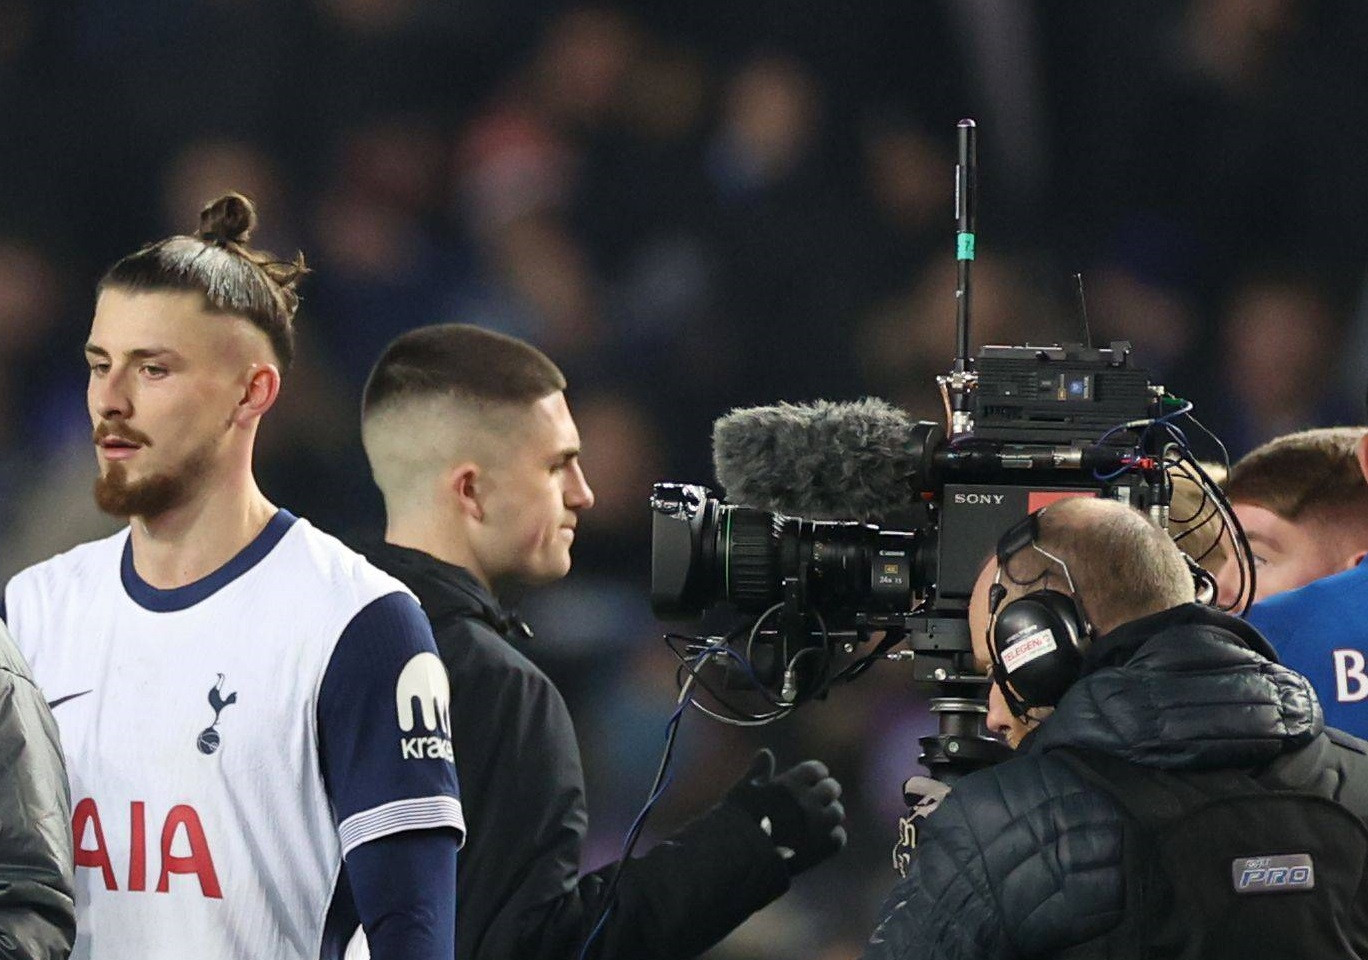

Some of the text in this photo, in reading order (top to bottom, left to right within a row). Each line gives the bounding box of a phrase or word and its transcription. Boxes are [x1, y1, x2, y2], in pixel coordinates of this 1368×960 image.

[954, 493, 1004, 505] SONY
[72, 797, 223, 900] AIA
[1239, 865, 1311, 888] PRO
